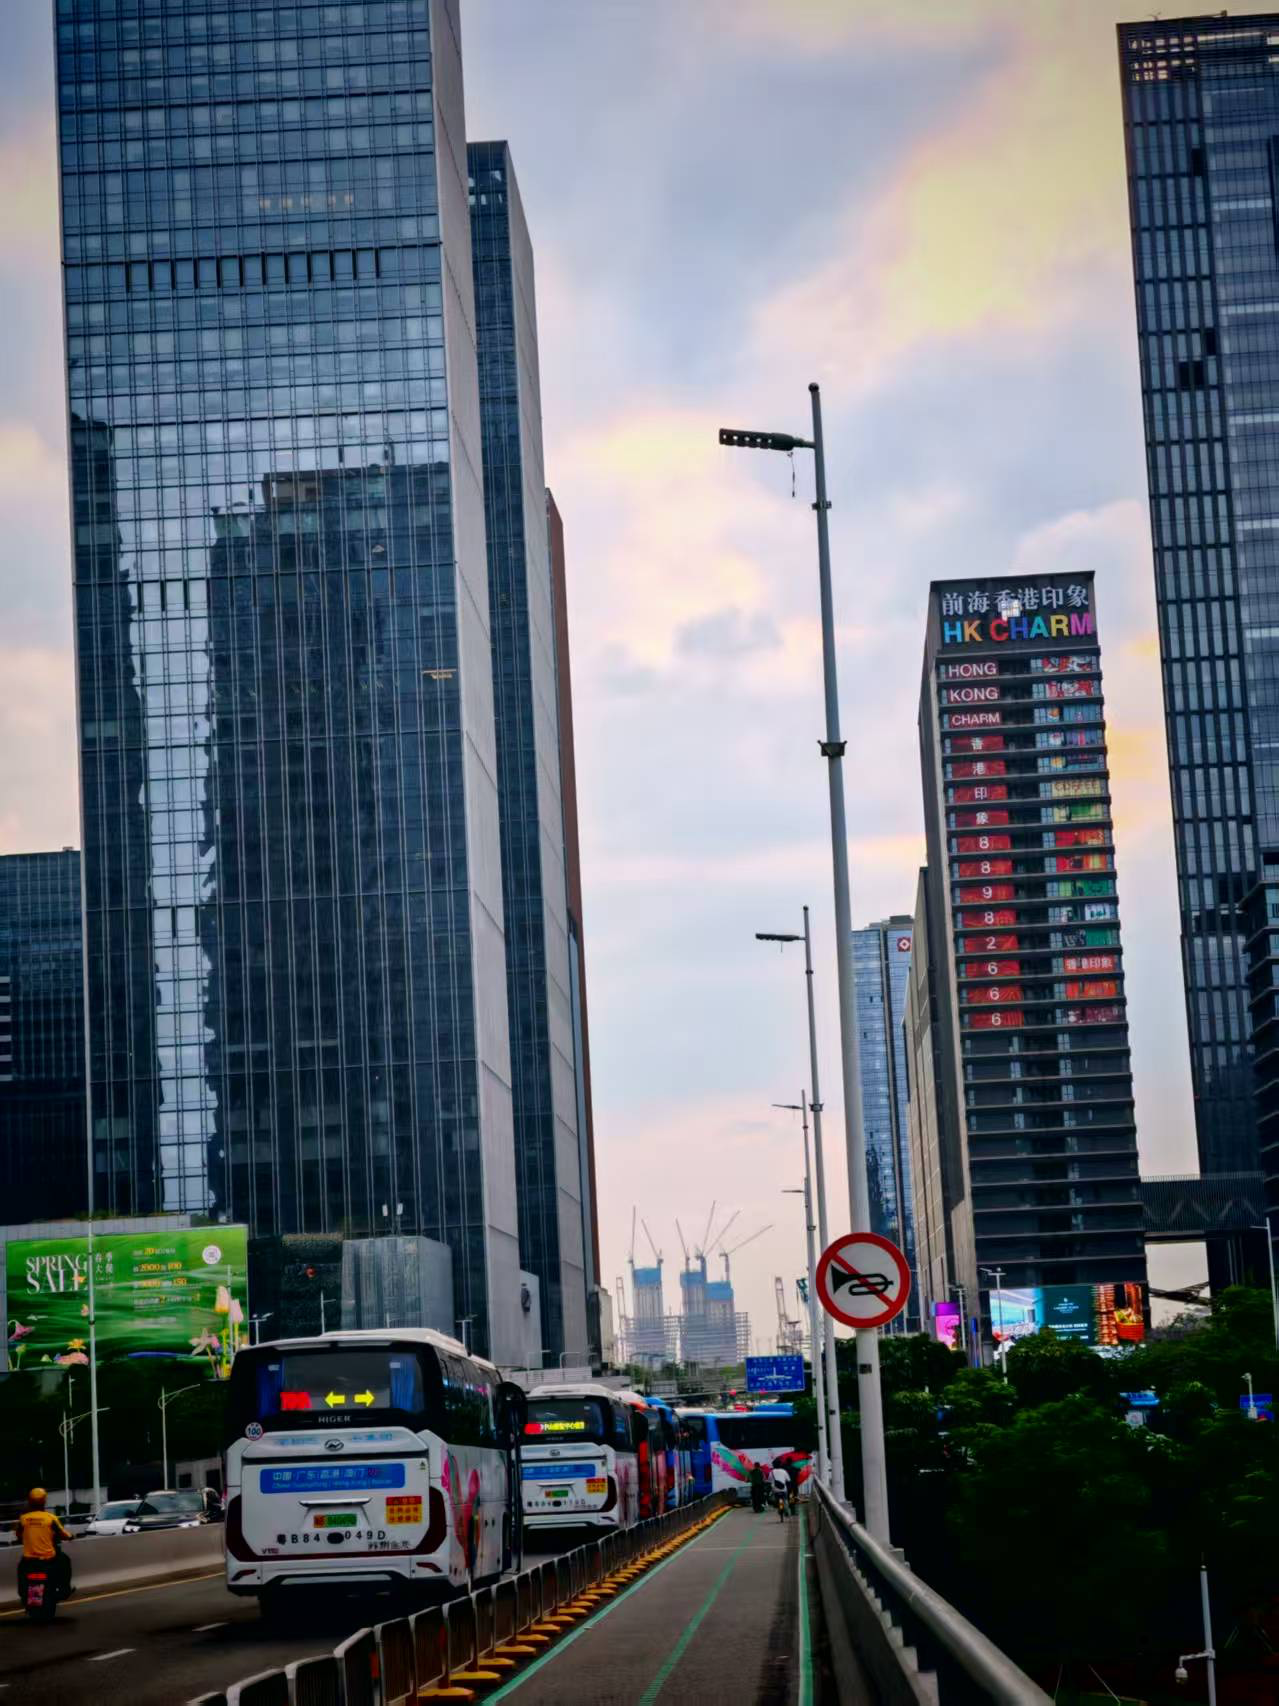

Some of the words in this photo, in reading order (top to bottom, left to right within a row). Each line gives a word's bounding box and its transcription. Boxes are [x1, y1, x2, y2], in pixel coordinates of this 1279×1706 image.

[943, 620, 983, 643] HK
[989, 612, 1093, 641] CHARM
[949, 662, 997, 677] HONG
[950, 687, 999, 702] KONG
[951, 712, 1000, 726] CHARM
[26, 1254, 88, 1276] SPRING
[26, 1268, 88, 1295] SALE
[248, 1428, 261, 1436] 100
